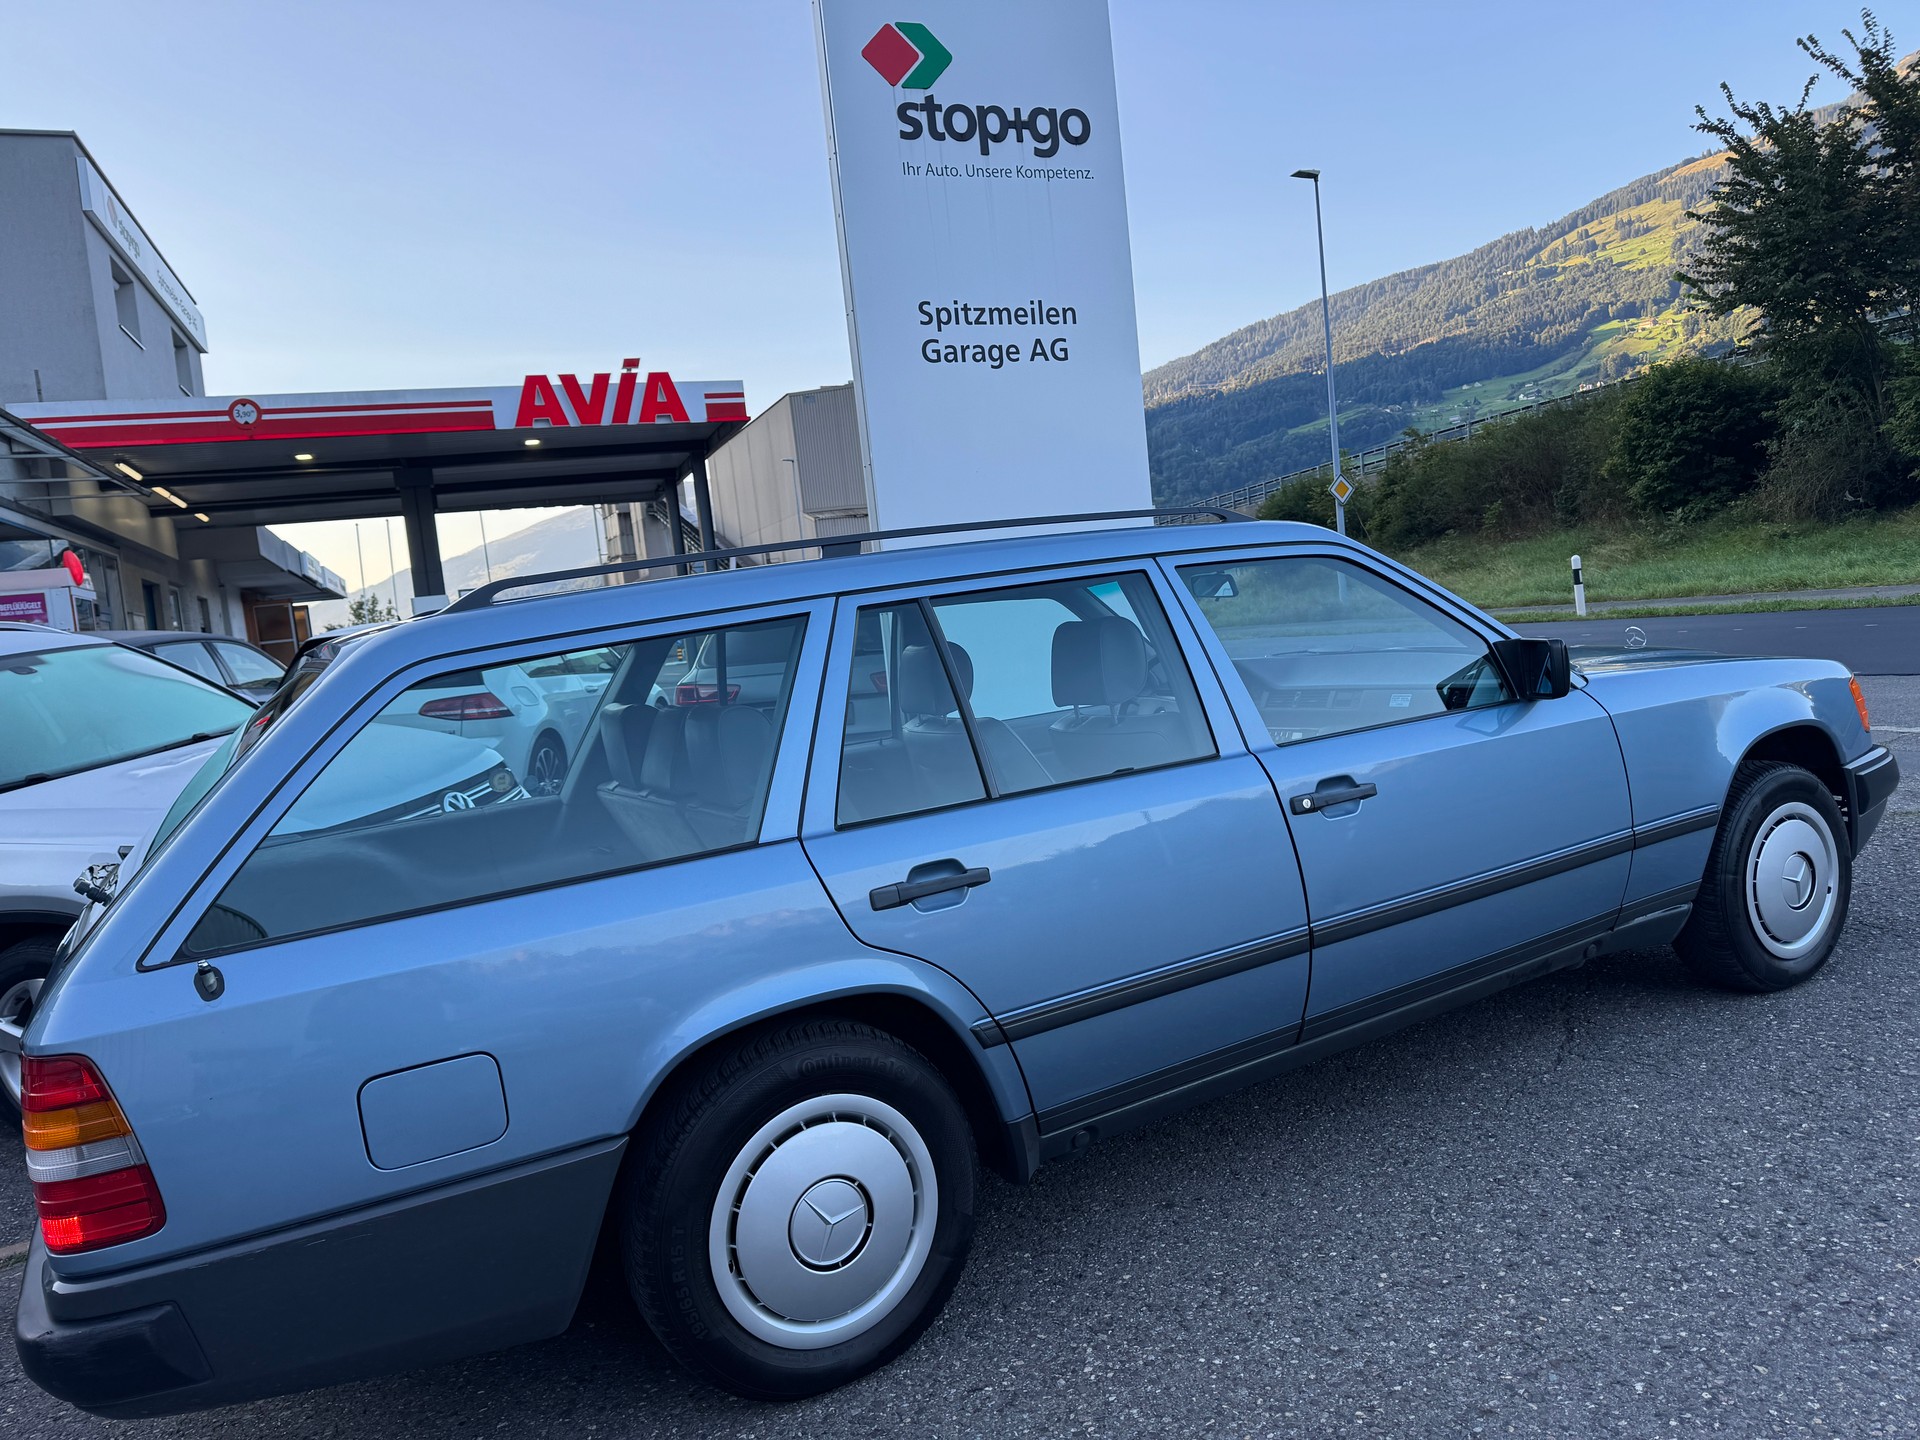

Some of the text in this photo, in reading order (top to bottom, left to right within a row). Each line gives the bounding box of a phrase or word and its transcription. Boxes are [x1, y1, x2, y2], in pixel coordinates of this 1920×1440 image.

[897, 94, 1091, 158] stop+go
[902, 162, 1095, 182] Ihr Auto. Unsere Kompetenz.
[917, 299, 1077, 332] Spitzmeilen
[921, 337, 1069, 370] Garage AG
[670, 1244, 685, 1265] 15
[672, 1269, 687, 1283] R
[675, 1286, 709, 1340] 195/65
